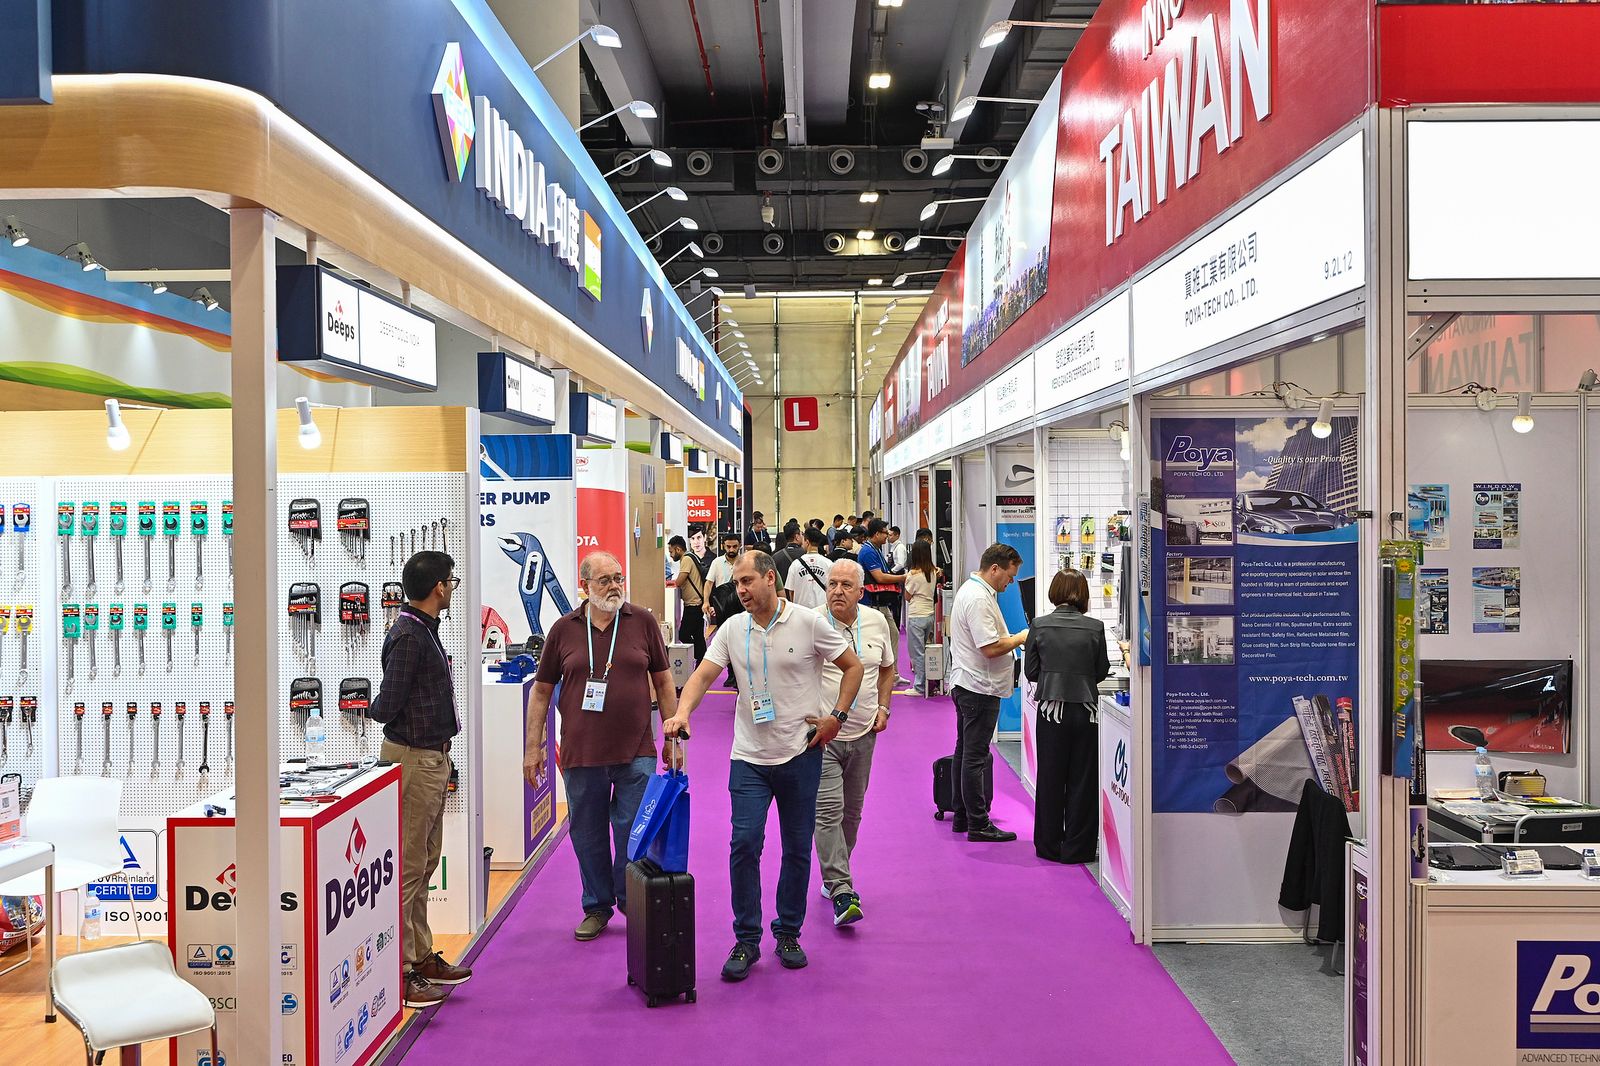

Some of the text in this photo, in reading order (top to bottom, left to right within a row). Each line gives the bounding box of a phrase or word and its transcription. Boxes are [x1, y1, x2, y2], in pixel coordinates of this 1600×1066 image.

[1100, 0, 1272, 247] TAIWAN
[475, 96, 549, 247] INDIA
[1185, 294, 1221, 327] POYA-TECH
[1242, 277, 1259, 301] LTD.
[327, 311, 355, 342] Deeps
[792, 402, 811, 427] L
[1165, 435, 1235, 472] Poya
[501, 491, 551, 505] PUMP
[687, 499, 705, 507] QUE
[1002, 497, 1028, 505] VEMAX
[687, 509, 712, 517] CHES
[1249, 674, 1349, 684] www.poya-tech.com.tw
[1396, 712, 1407, 738] FILM
[93, 871, 155, 883] VRheinland
[185, 885, 298, 911] Des
[325, 848, 393, 936] Deeps
[105, 911, 130, 922] ISO
[1522, 1053, 1568, 1063] ADVANCED
